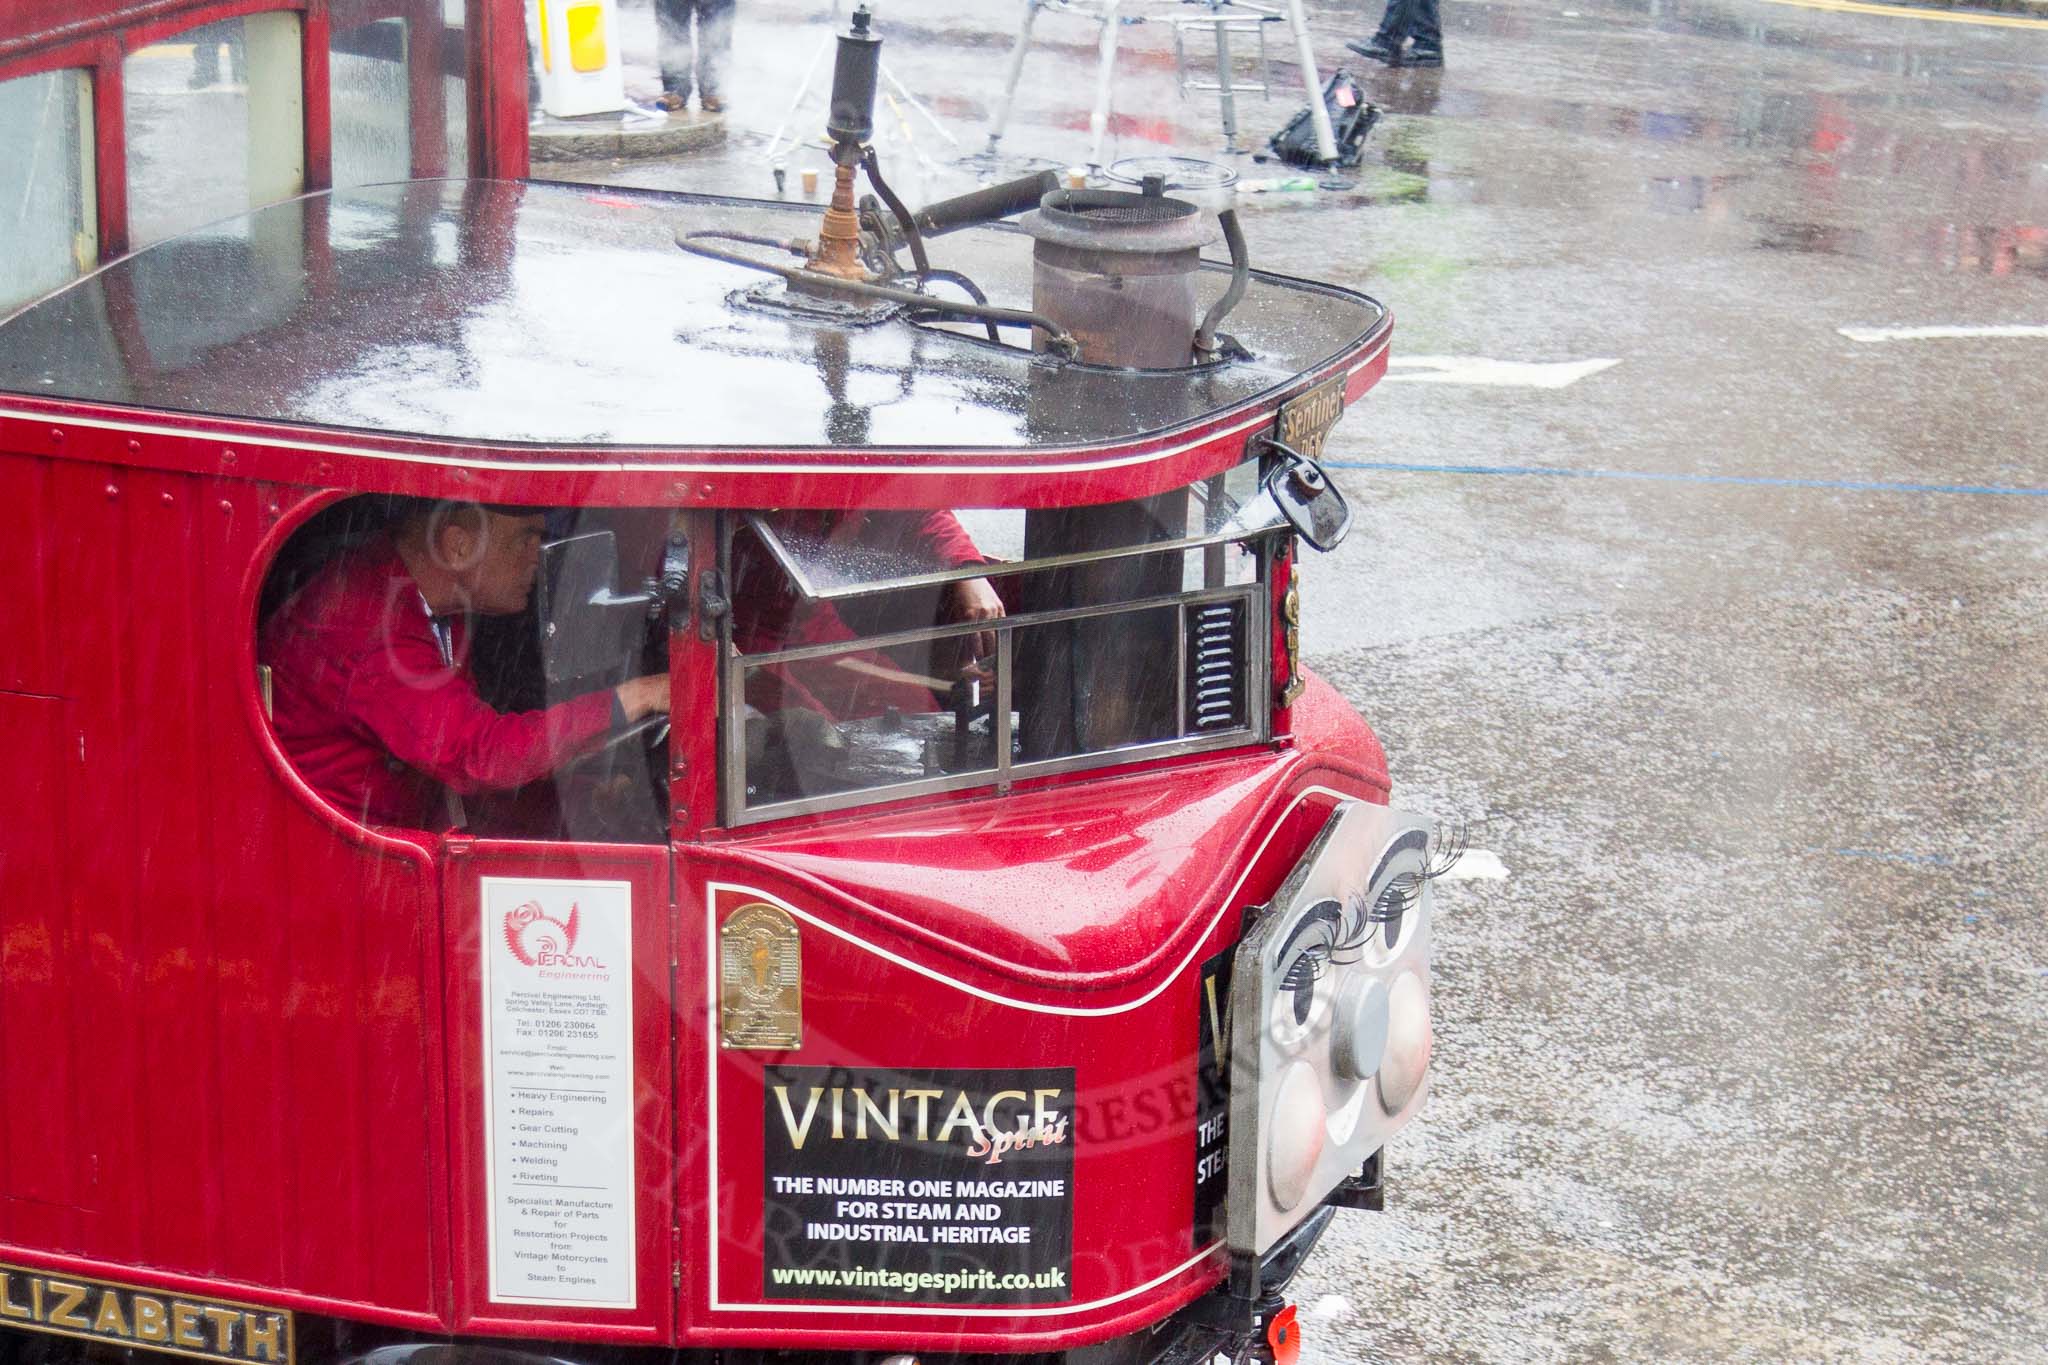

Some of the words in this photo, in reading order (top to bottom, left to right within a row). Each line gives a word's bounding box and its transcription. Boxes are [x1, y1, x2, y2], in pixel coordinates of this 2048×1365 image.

[1285, 384, 1341, 442] Sentinel
[538, 970, 610, 983] Engineering
[535, 1020, 561, 1028] 01206
[567, 1030, 599, 1039] 231655
[517, 1091, 547, 1102] Heavy
[550, 1092, 607, 1104] Engineering
[518, 1107, 554, 1117] Repairs
[772, 1086, 1062, 1150] VINTAGE
[519, 1123, 541, 1132] Gear
[544, 1124, 578, 1135] Cutting
[1199, 1112, 1225, 1147] THE
[966, 1112, 1069, 1164] Spirit
[519, 1140, 568, 1151] Machining
[519, 1156, 558, 1166] Welding
[519, 1171, 558, 1182] Riveting
[772, 1176, 813, 1195] THE
[817, 1177, 906, 1197] NUMBER
[908, 1179, 952, 1198] ONE
[956, 1180, 1065, 1198] MAGAZINE
[507, 1196, 553, 1207] Specialist
[555, 1198, 614, 1209] Manufacture
[521, 1208, 529, 1216] &
[531, 1208, 561, 1218] Repair
[575, 1210, 600, 1220] Parts
[836, 1201, 883, 1219] FOR
[883, 1202, 951, 1221] STEAM
[954, 1204, 1001, 1221] AND
[554, 1221, 568, 1229] for
[513, 1229, 568, 1239] Restoration
[570, 1231, 608, 1242] Projects
[807, 1223, 929, 1243] INDUSTRIAL
[932, 1225, 1031, 1244] HERITAGE
[550, 1242, 573, 1250] from
[514, 1251, 549, 1261] Vintage
[551, 1252, 608, 1264] Motorcycles
[557, 1264, 566, 1272] to
[527, 1273, 556, 1283] Steam
[559, 1275, 597, 1285] Engines
[772, 1266, 1066, 1293] www.vintagespirit.co.uk
